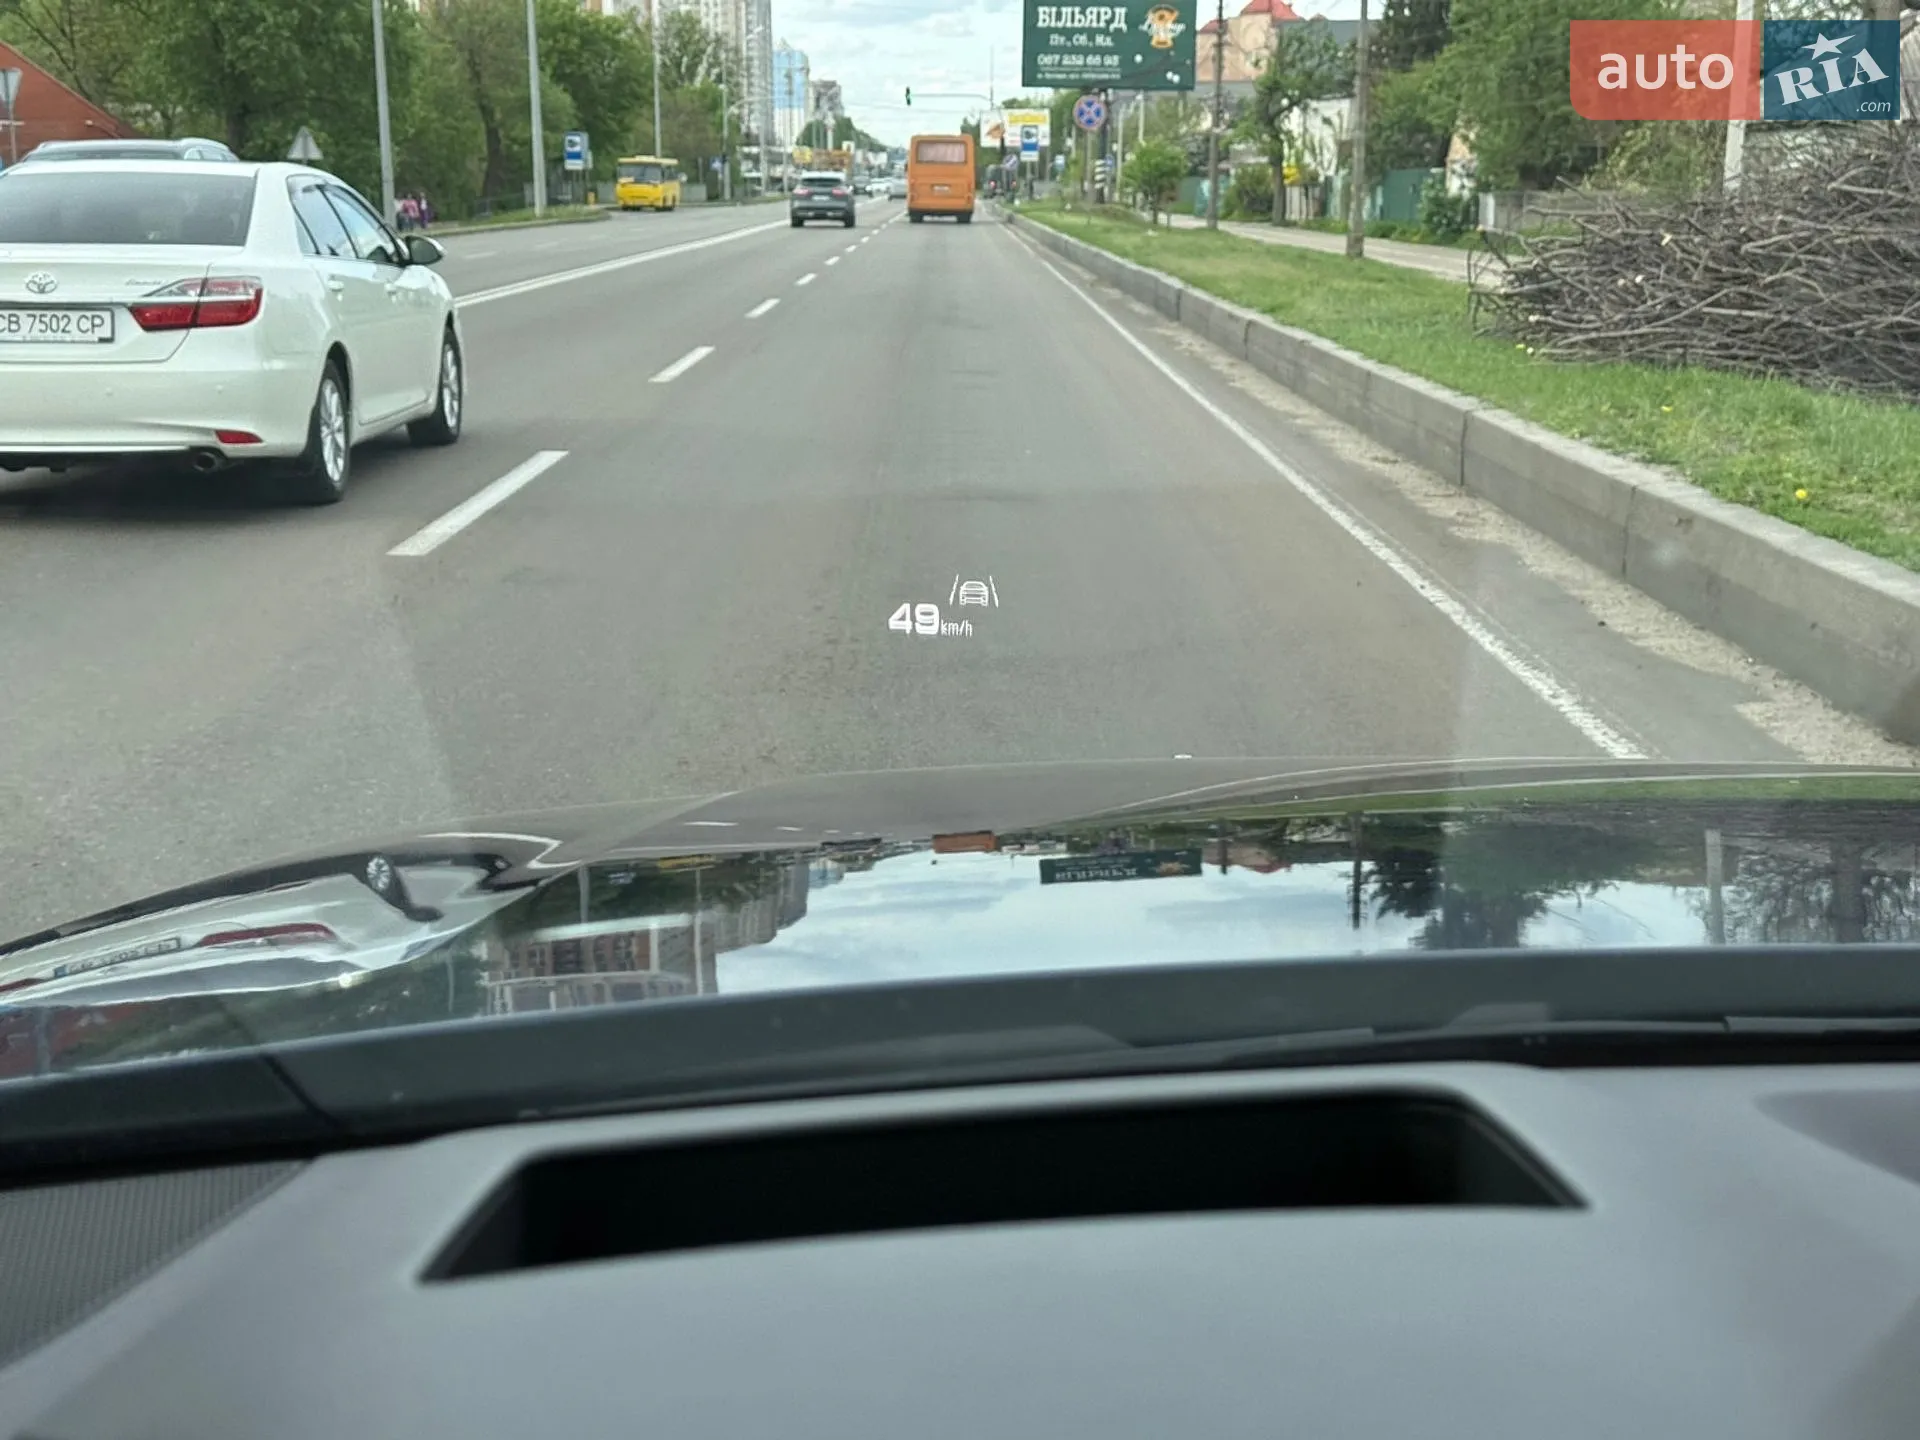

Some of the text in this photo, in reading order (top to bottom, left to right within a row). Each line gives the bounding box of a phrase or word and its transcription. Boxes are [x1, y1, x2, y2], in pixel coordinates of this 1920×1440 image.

[1036, 6, 1128, 33] БІЛЬЯРД
[25, 313, 72, 334] 7502
[77, 314, 105, 334] CP
[888, 602, 973, 637] 49 km/h
